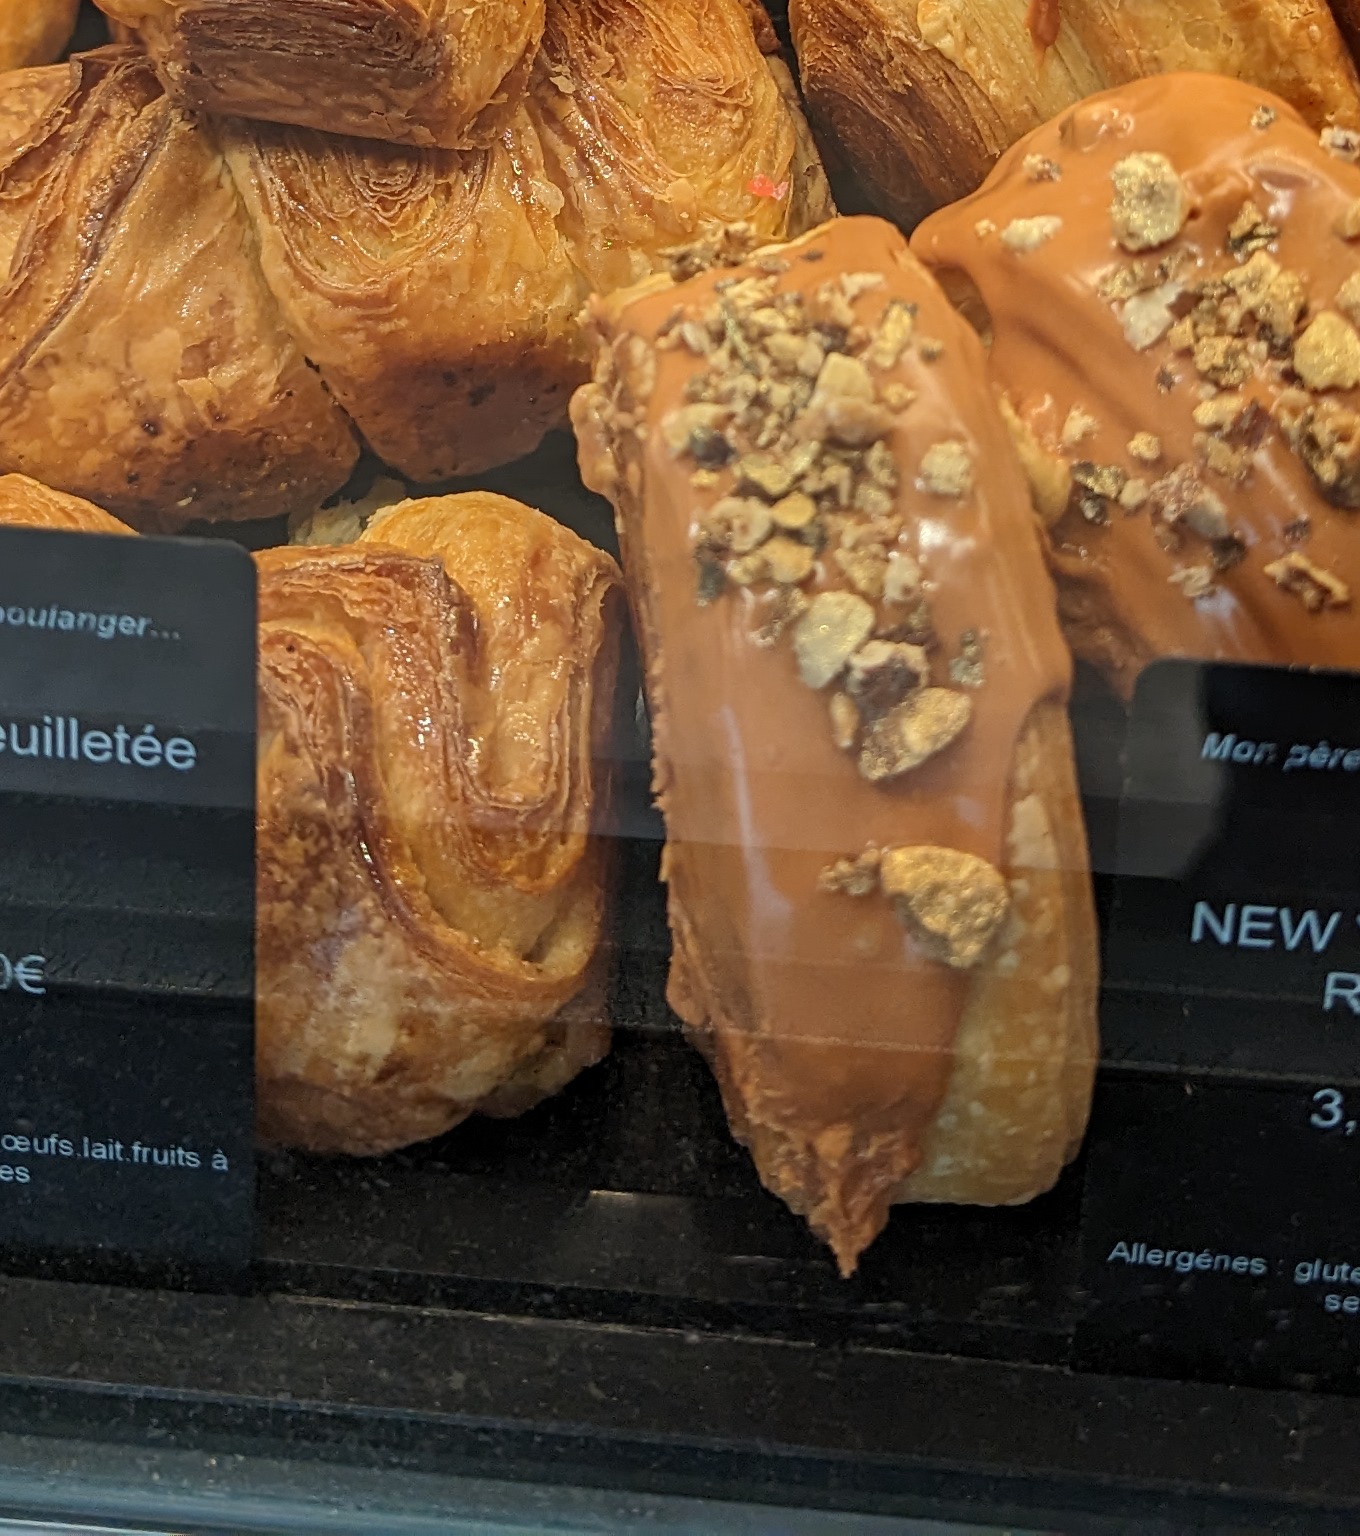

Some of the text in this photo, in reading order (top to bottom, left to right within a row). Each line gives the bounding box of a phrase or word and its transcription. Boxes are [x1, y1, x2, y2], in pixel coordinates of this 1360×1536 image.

[1200, 732, 1277, 764] Mon
[1190, 900, 1342, 954] NEW
[211, 1148, 230, 1173] à
